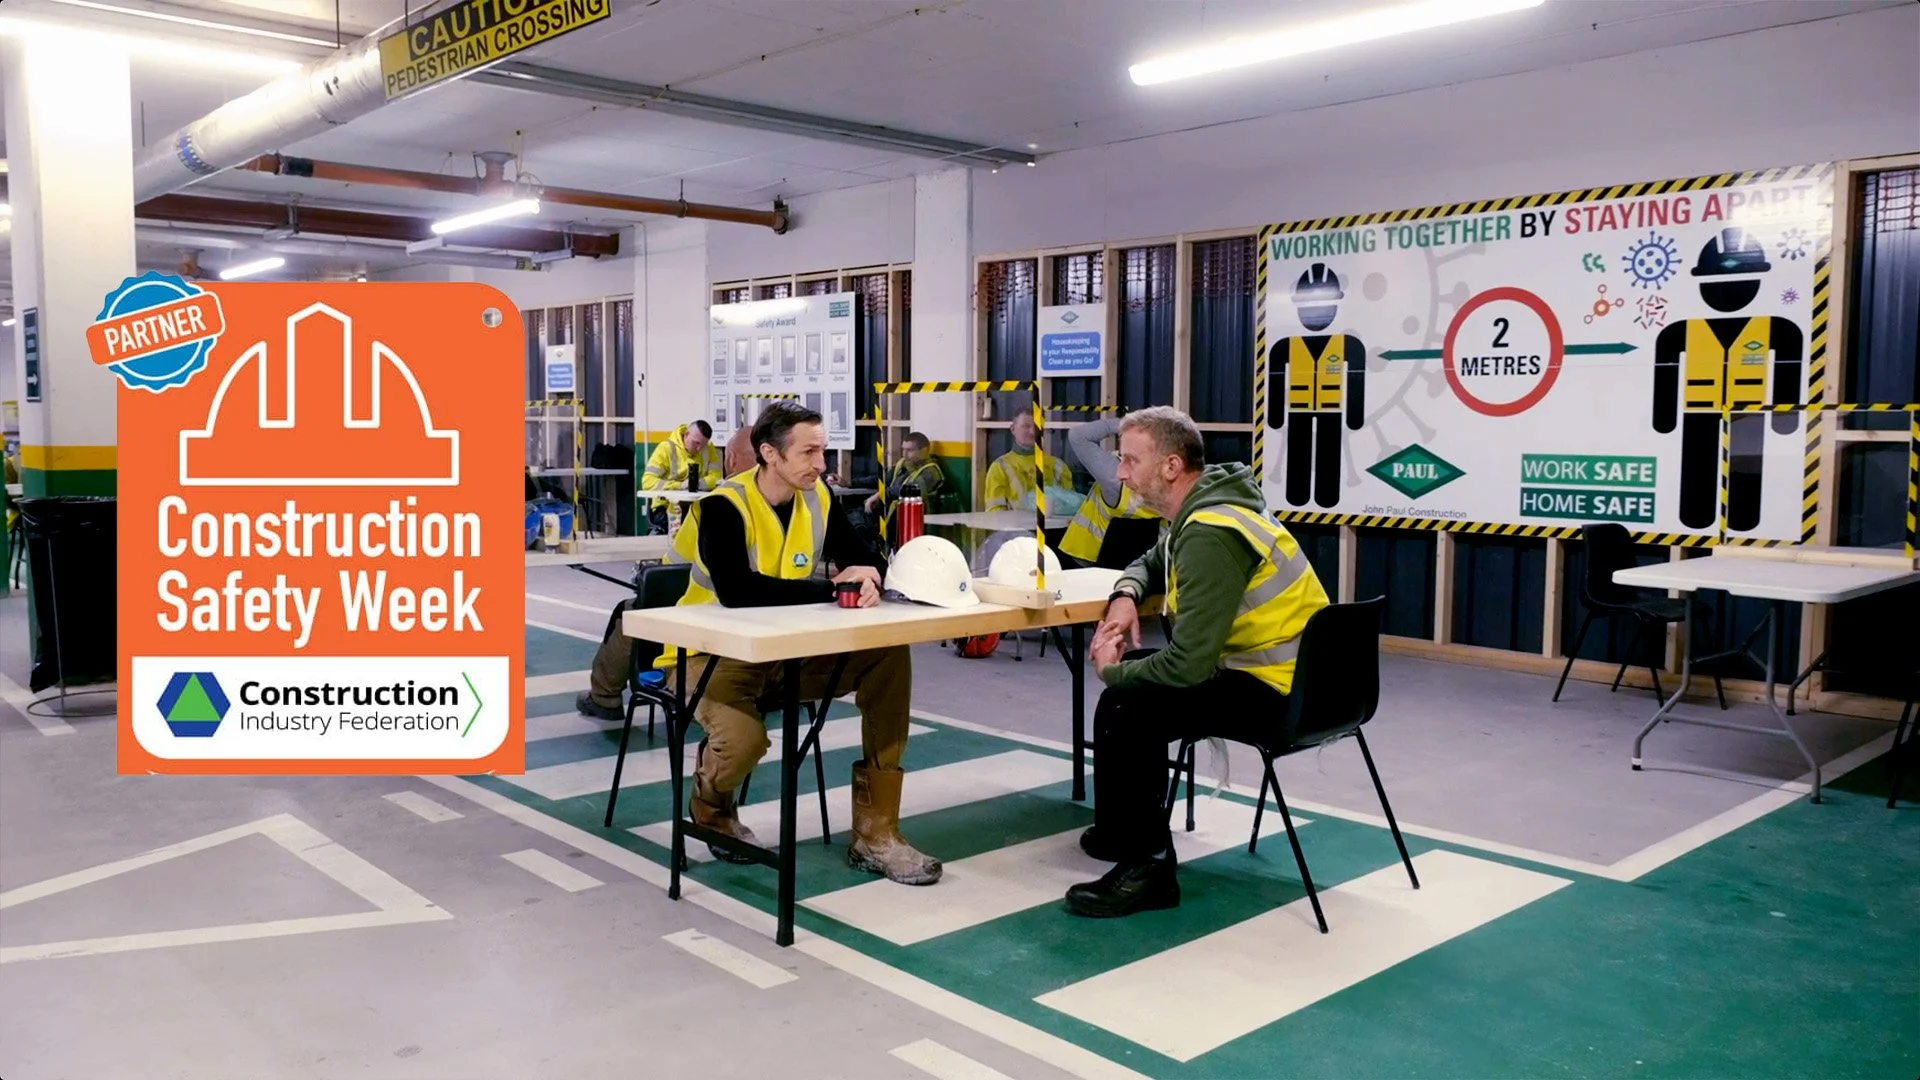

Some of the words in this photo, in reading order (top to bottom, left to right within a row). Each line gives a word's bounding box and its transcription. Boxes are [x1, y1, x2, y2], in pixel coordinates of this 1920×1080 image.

[411, 0, 540, 56] CAUTIO
[387, 35, 489, 95] PEDESTRIAN
[494, 0, 603, 51] CROSSING
[1271, 228, 1376, 260] WORKING
[1384, 215, 1511, 250] TOGETHER
[1521, 210, 1556, 238] BY
[1565, 196, 1691, 234] STAYING
[1492, 317, 1510, 348] 2
[1461, 355, 1541, 376] METRES
[1392, 462, 1438, 480] PAUL
[1523, 460, 1587, 480] WORK
[1593, 461, 1652, 482] SAFE
[1362, 504, 1384, 514] John
[1387, 505, 1406, 515] Paul
[1408, 507, 1467, 518] Construction
[1522, 493, 1586, 514] HOME
[1593, 496, 1652, 517] SAFE
